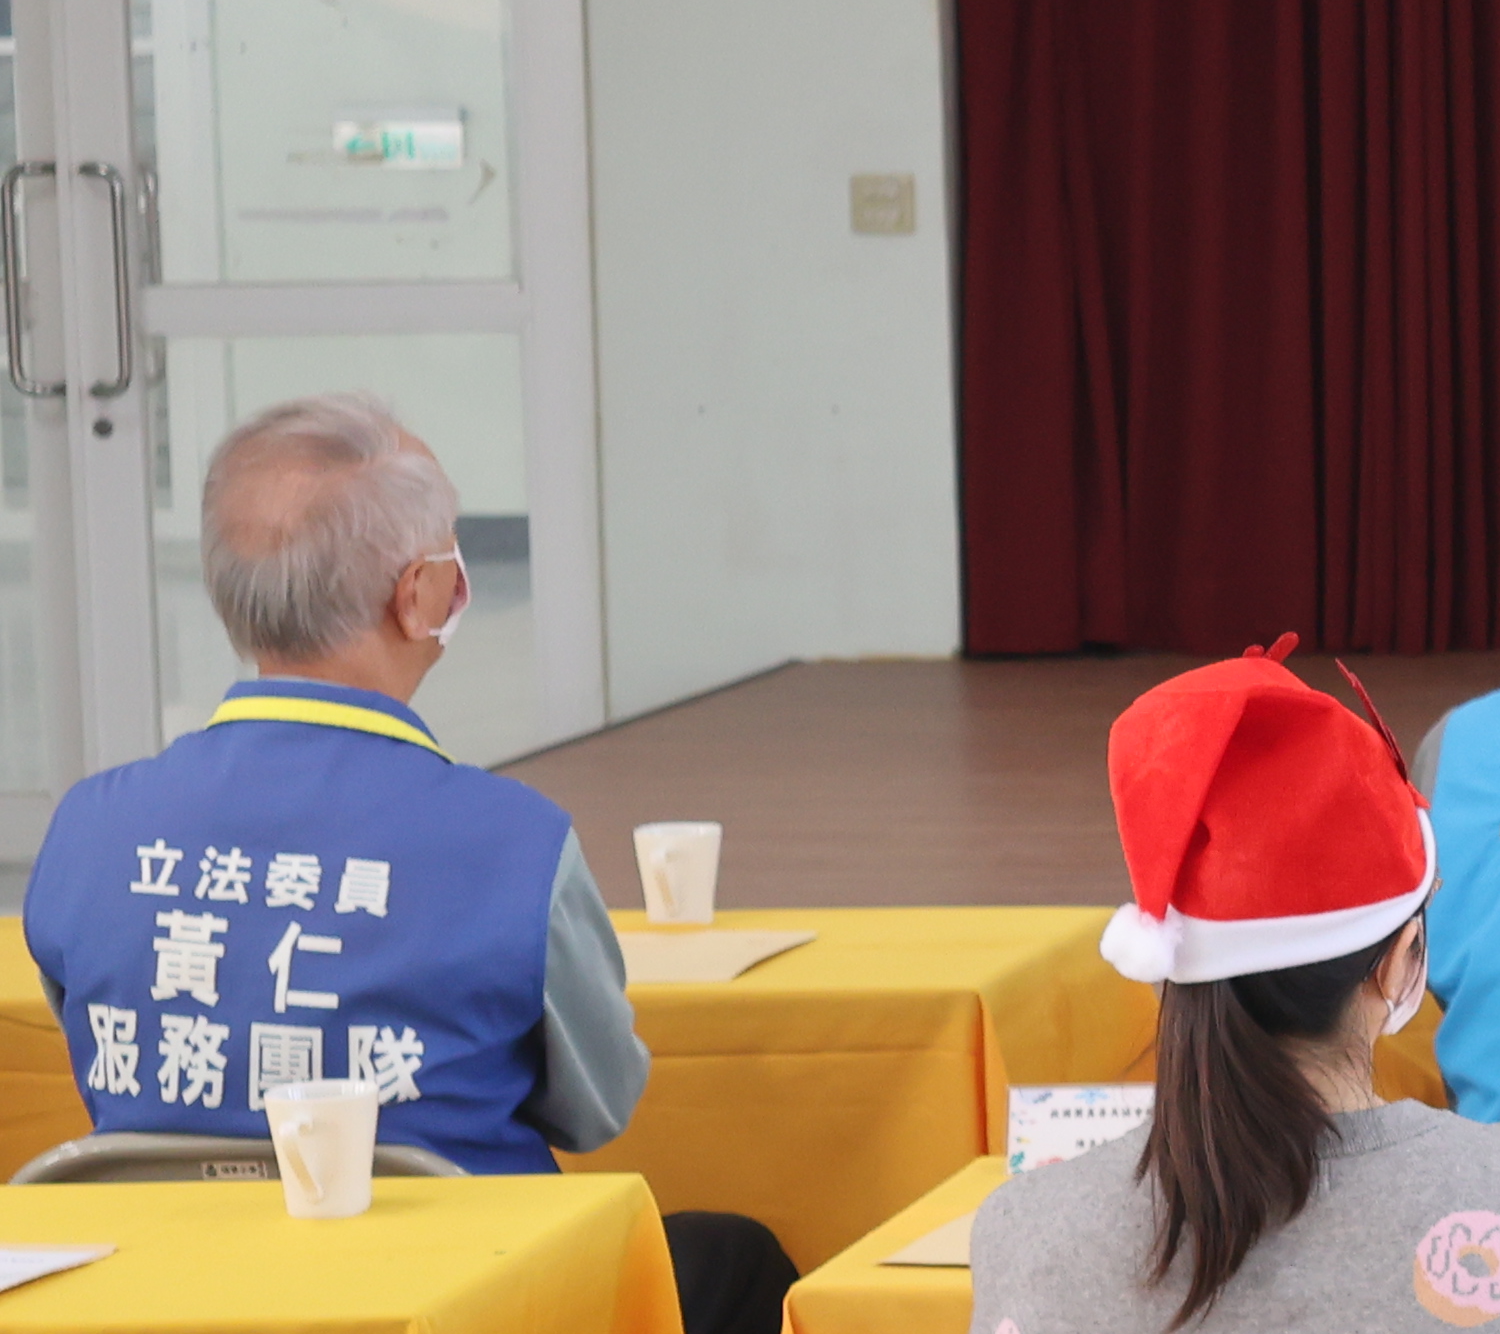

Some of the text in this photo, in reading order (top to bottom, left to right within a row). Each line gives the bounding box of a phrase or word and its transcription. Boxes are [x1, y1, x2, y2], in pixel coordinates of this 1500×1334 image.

[130, 838, 392, 919] 立法委員
[150, 910, 343, 1013] 黃仁
[86, 1003, 425, 1113] 服務團隊
